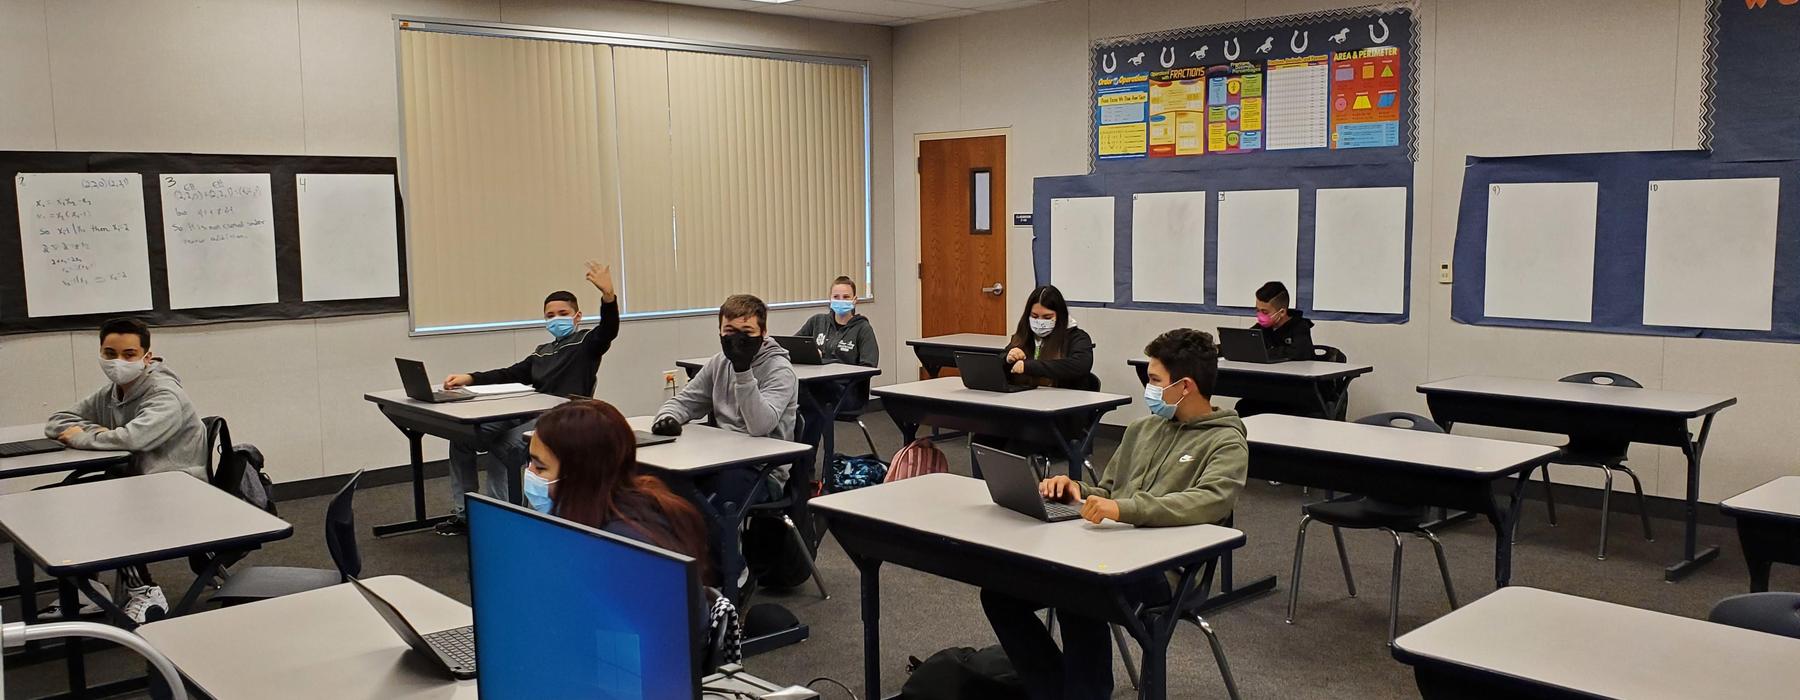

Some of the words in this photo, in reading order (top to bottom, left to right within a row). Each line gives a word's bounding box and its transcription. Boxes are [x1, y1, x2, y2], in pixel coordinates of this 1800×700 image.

[1334, 52, 1352, 61] AREA
[1358, 47, 1398, 59] PERIMETER
[1169, 67, 1205, 79] FRACTIONS
[165, 177, 177, 188] 3
[299, 177, 306, 193] 4
[1650, 183, 1659, 192] 10
[91, 225, 110, 233] then
